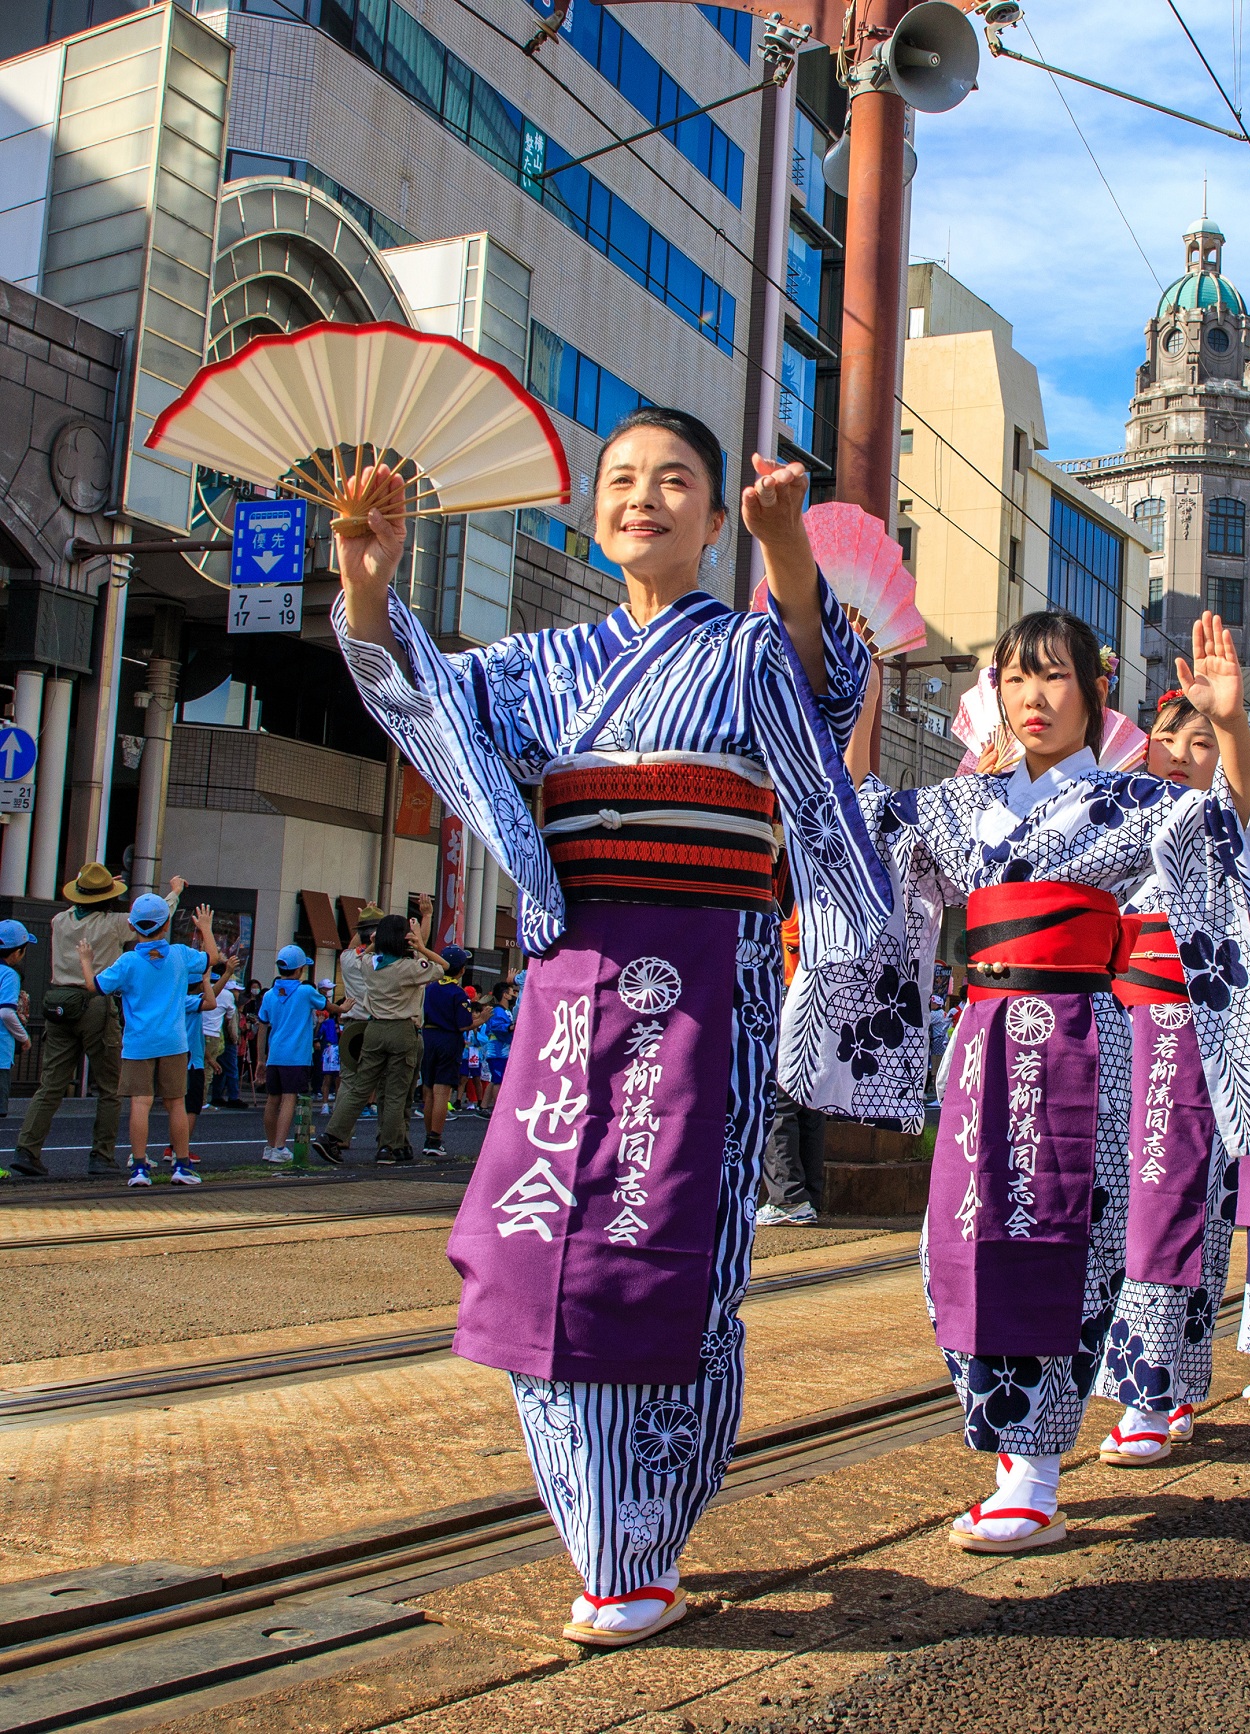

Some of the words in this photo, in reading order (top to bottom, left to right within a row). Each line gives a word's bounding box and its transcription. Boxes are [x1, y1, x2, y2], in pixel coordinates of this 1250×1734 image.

[252, 533, 286, 550] 優先
[603, 1020, 664, 1246] 若柳流同志会
[1005, 1050, 1043, 1238] 若柳流同志会
[1138, 1033, 1179, 1185] 若柳流同志会
